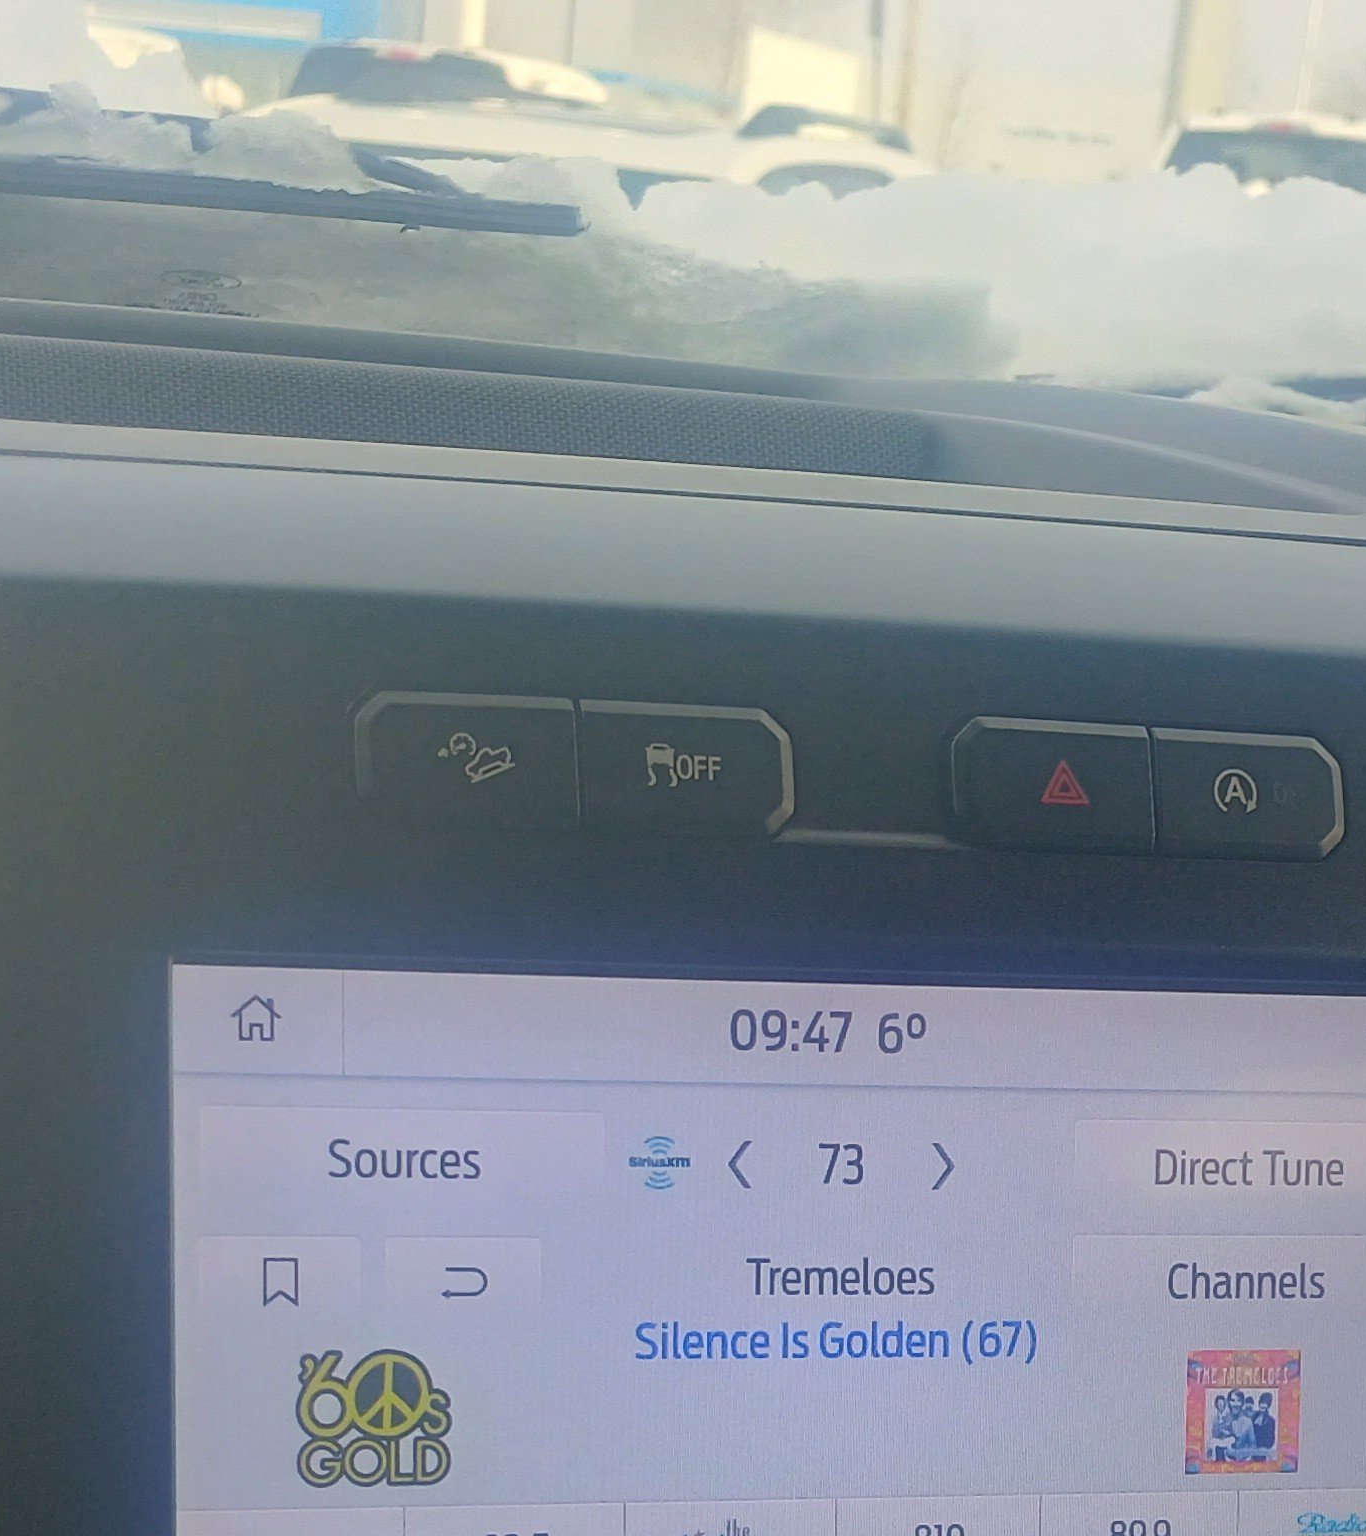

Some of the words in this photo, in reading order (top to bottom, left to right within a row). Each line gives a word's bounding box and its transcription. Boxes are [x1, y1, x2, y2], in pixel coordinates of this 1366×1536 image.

[676, 754, 722, 781] OFF
[730, 1009, 853, 1053] 09:47
[327, 1139, 482, 1180] Sources
[817, 1143, 865, 1185] 73
[1154, 1148, 1253, 1187] Direct
[1262, 1150, 1345, 1187] Tune
[746, 1257, 936, 1297] Tremeloes
[1167, 1263, 1326, 1301] Channels
[635, 1322, 770, 1361] Silence
[781, 1323, 811, 1359] Is
[819, 1320, 950, 1359] Golden
[961, 1320, 1038, 1365] (67)
[296, 1438, 452, 1489] GOLD
